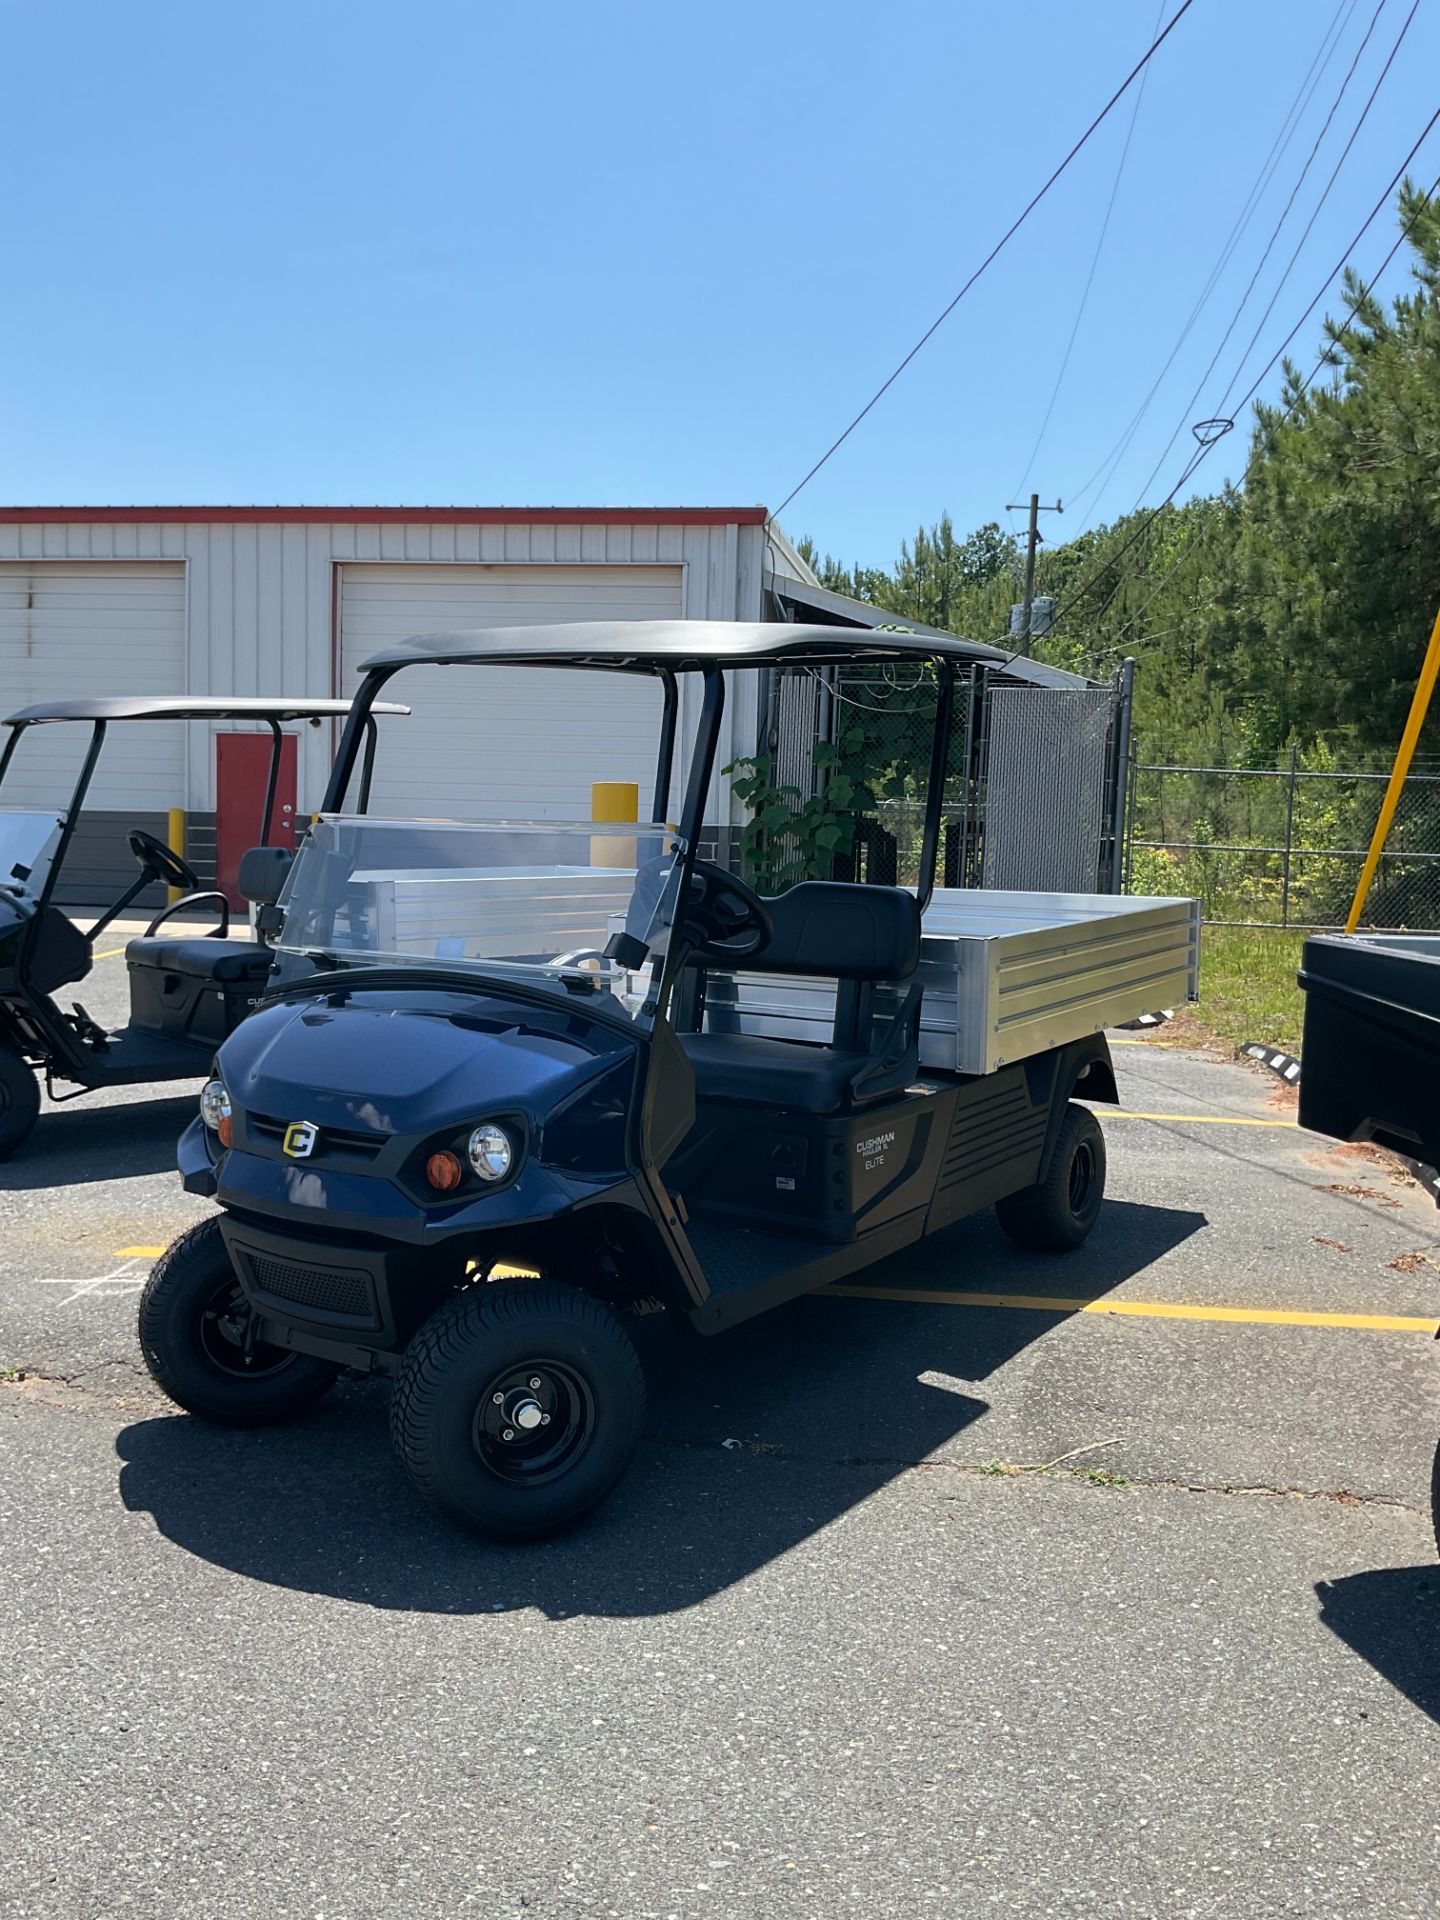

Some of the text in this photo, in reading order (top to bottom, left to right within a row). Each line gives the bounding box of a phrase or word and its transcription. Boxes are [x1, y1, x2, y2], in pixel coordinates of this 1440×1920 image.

[286, 1127, 313, 1154] C
[857, 1131, 895, 1153] CUSHMAN
[865, 1155, 885, 1170] ELITE
